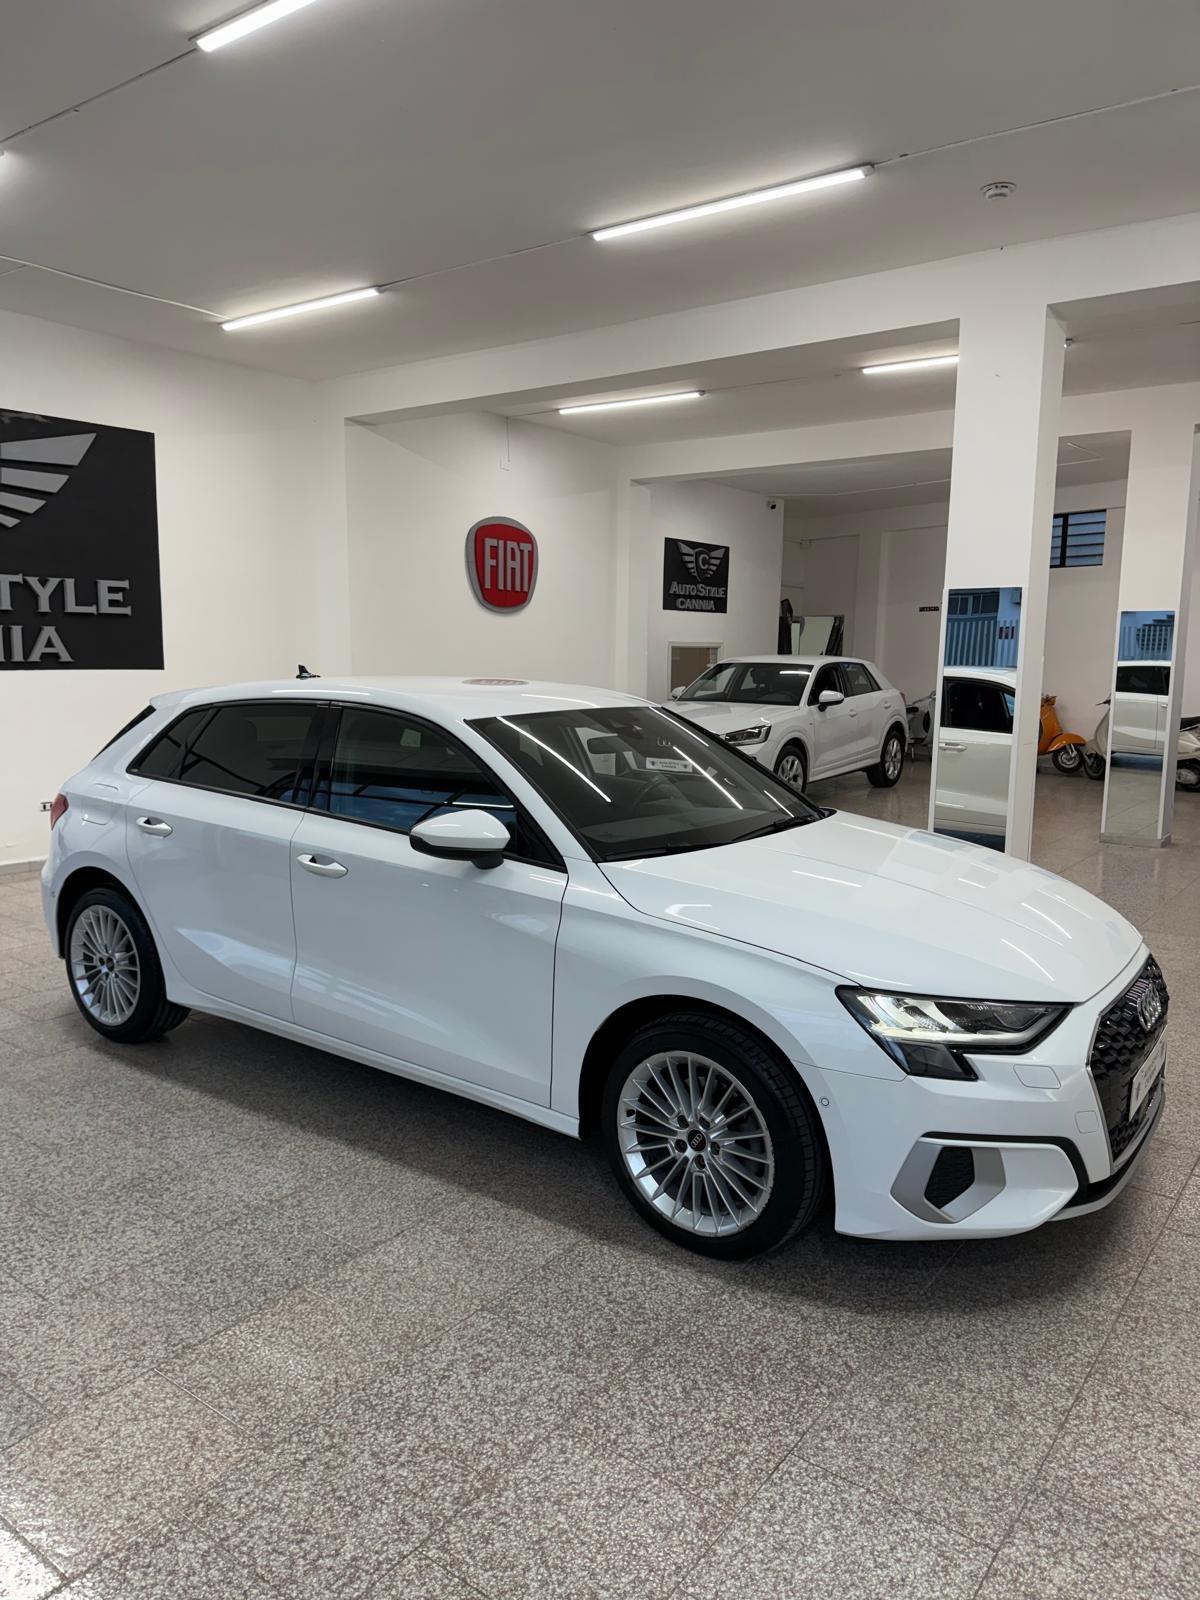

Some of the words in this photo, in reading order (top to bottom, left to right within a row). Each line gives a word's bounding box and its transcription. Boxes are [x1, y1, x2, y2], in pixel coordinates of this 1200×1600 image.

[484, 537, 532, 592] FIAT
[676, 598, 715, 611] CANNIA
[0, 624, 74, 662] IA
